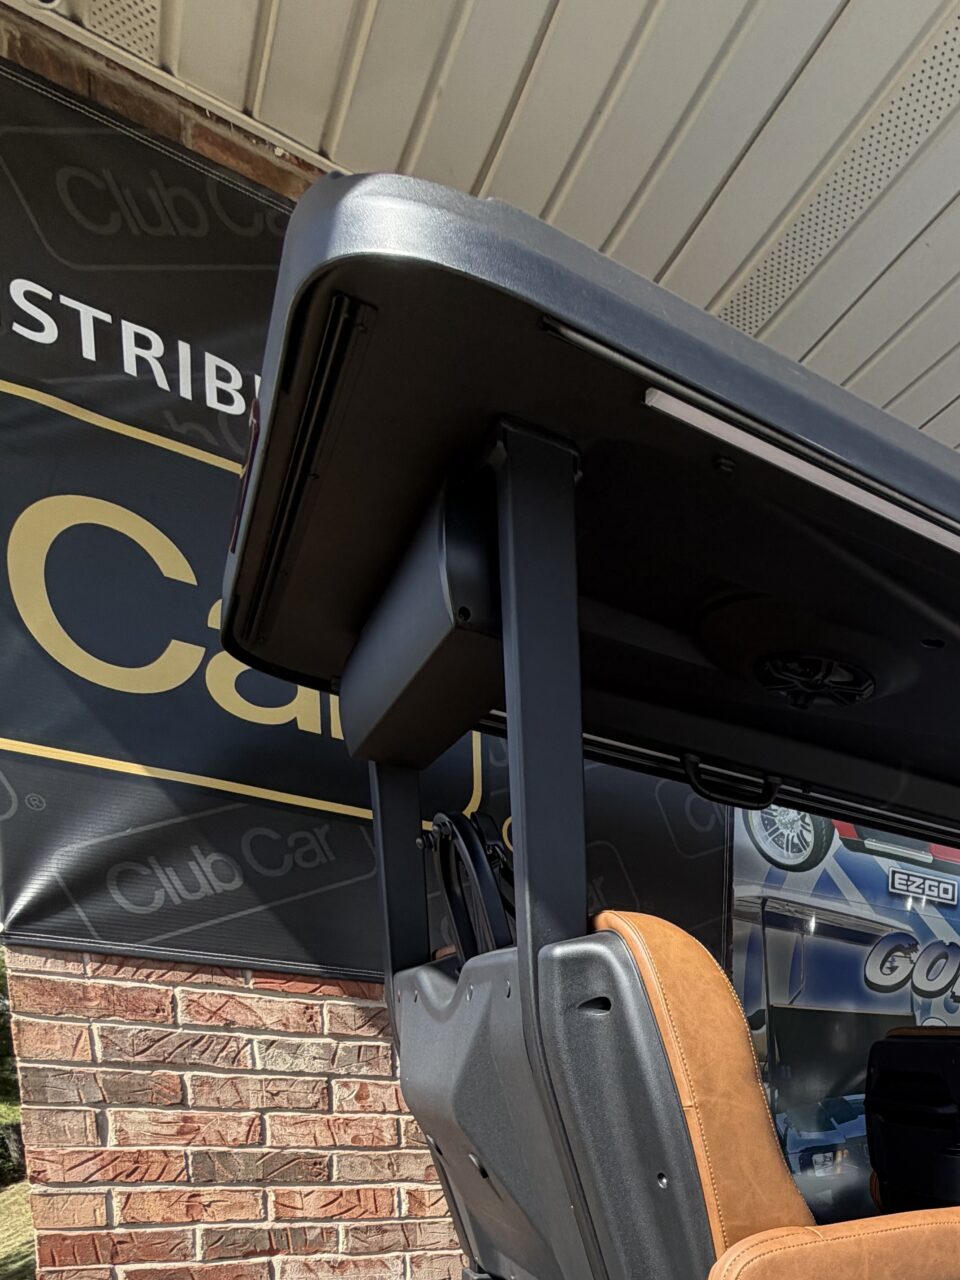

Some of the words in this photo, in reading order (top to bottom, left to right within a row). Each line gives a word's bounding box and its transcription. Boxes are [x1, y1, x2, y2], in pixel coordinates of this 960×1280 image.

[9, 278, 262, 416] STRIB
[7, 494, 344, 738] Ca
[106, 845, 244, 915] Club
[240, 823, 336, 878] Car
